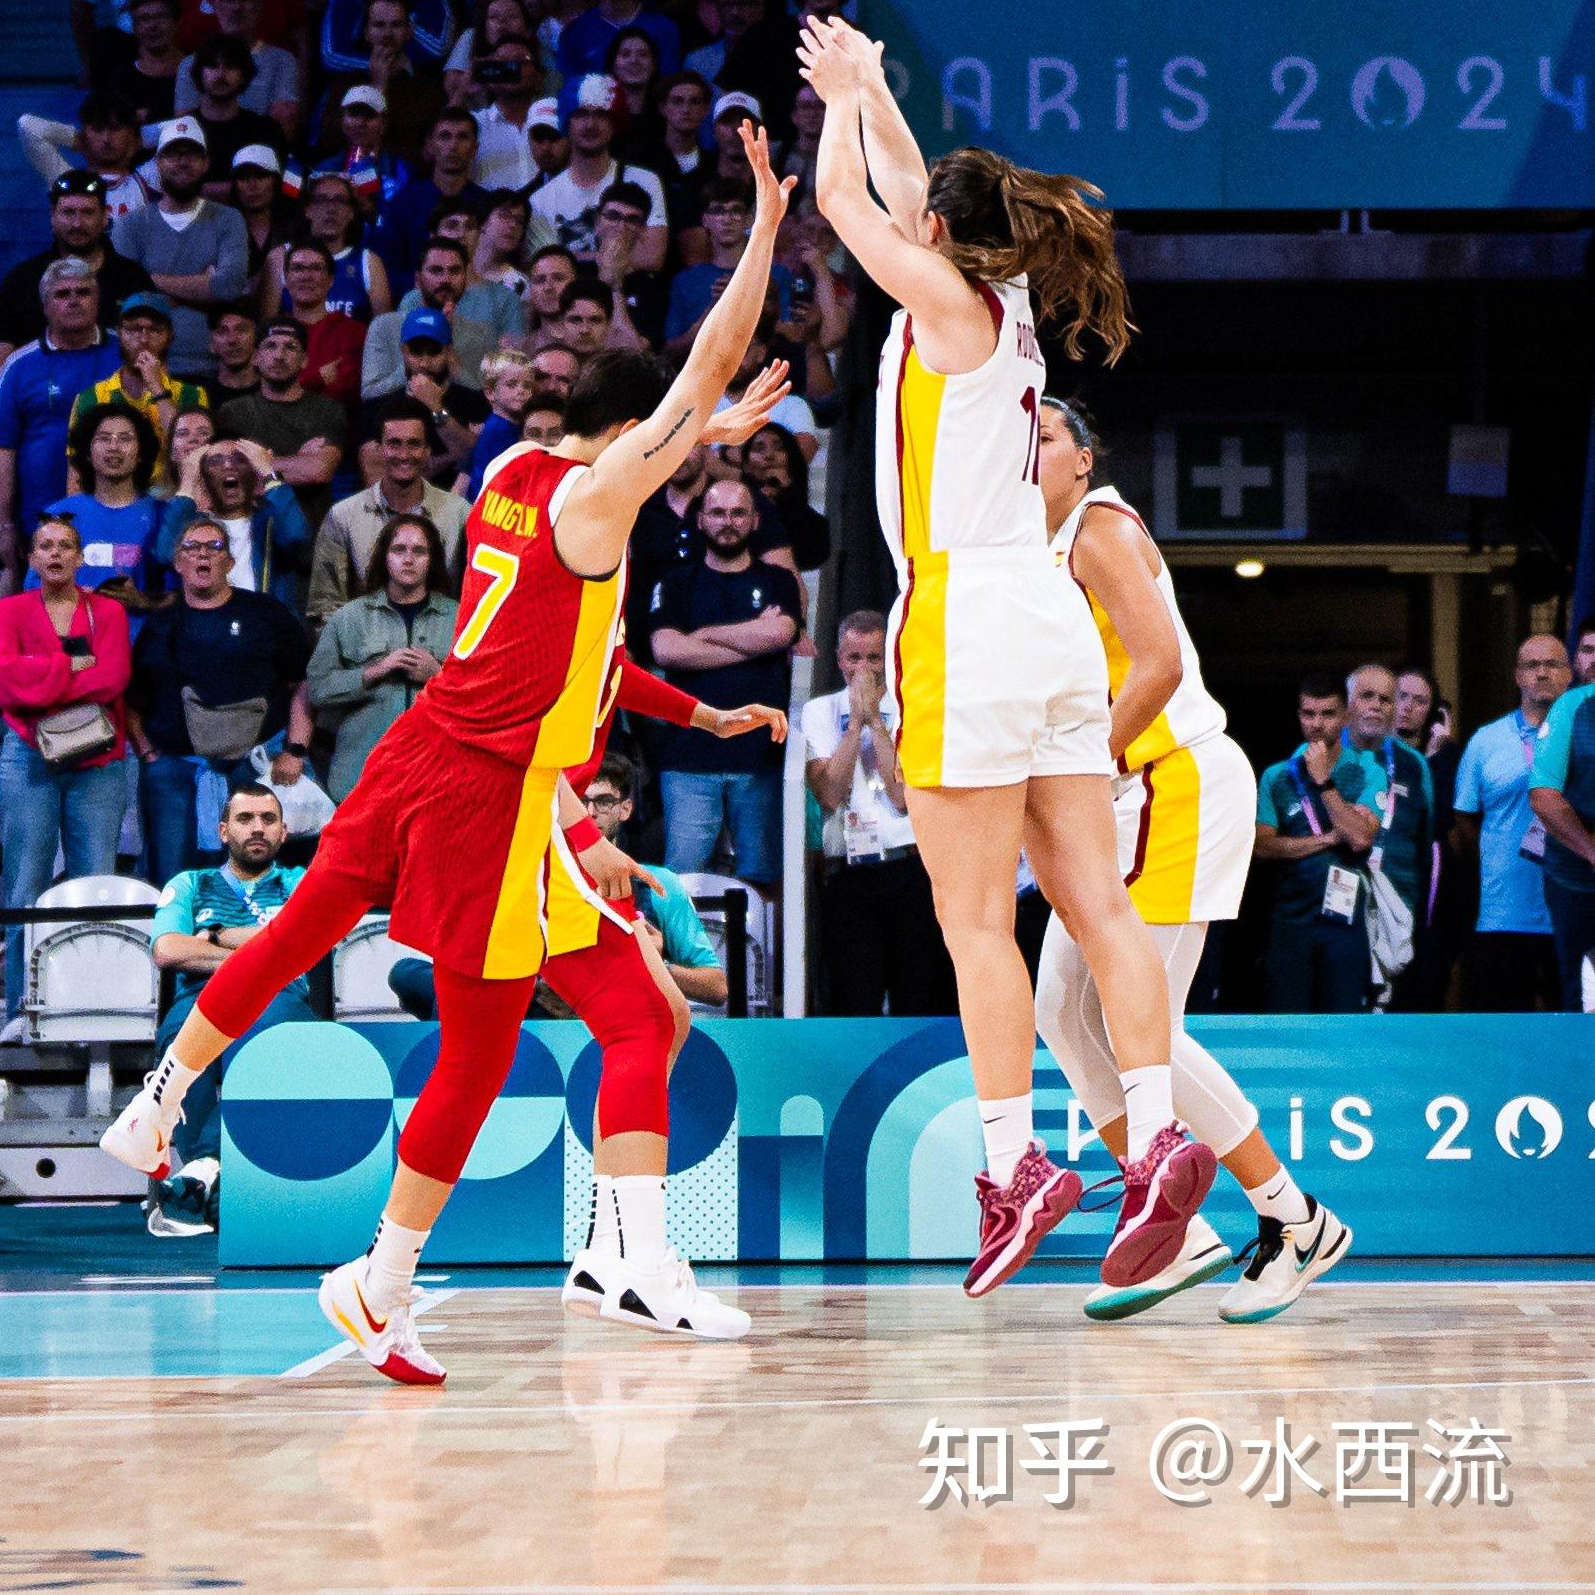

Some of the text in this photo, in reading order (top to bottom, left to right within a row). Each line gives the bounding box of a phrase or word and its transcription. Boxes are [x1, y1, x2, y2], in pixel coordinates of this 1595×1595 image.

[1270, 55, 1588, 132] 2024
[482, 489, 523, 532] YANG
[453, 543, 520, 661] 7
